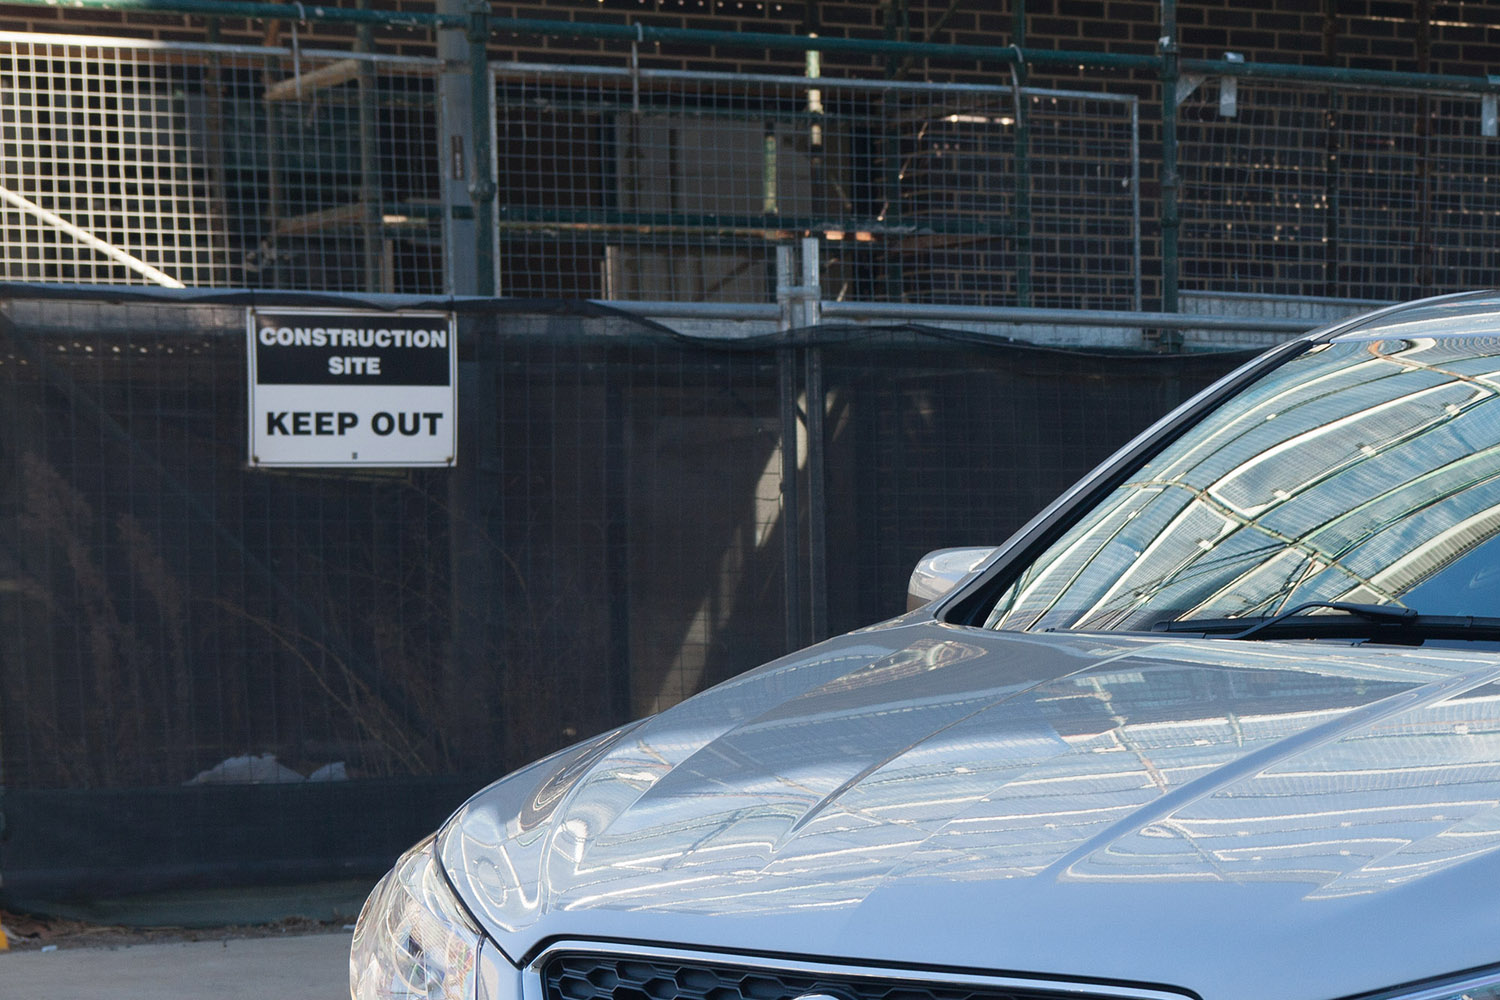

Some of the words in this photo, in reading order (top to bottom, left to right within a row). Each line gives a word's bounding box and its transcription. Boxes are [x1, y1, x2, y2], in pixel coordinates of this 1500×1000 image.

[259, 327, 447, 348] CONSTRUCTION
[328, 356, 381, 375] SITE
[266, 411, 359, 436] KEEP
[371, 411, 443, 436] OUT
